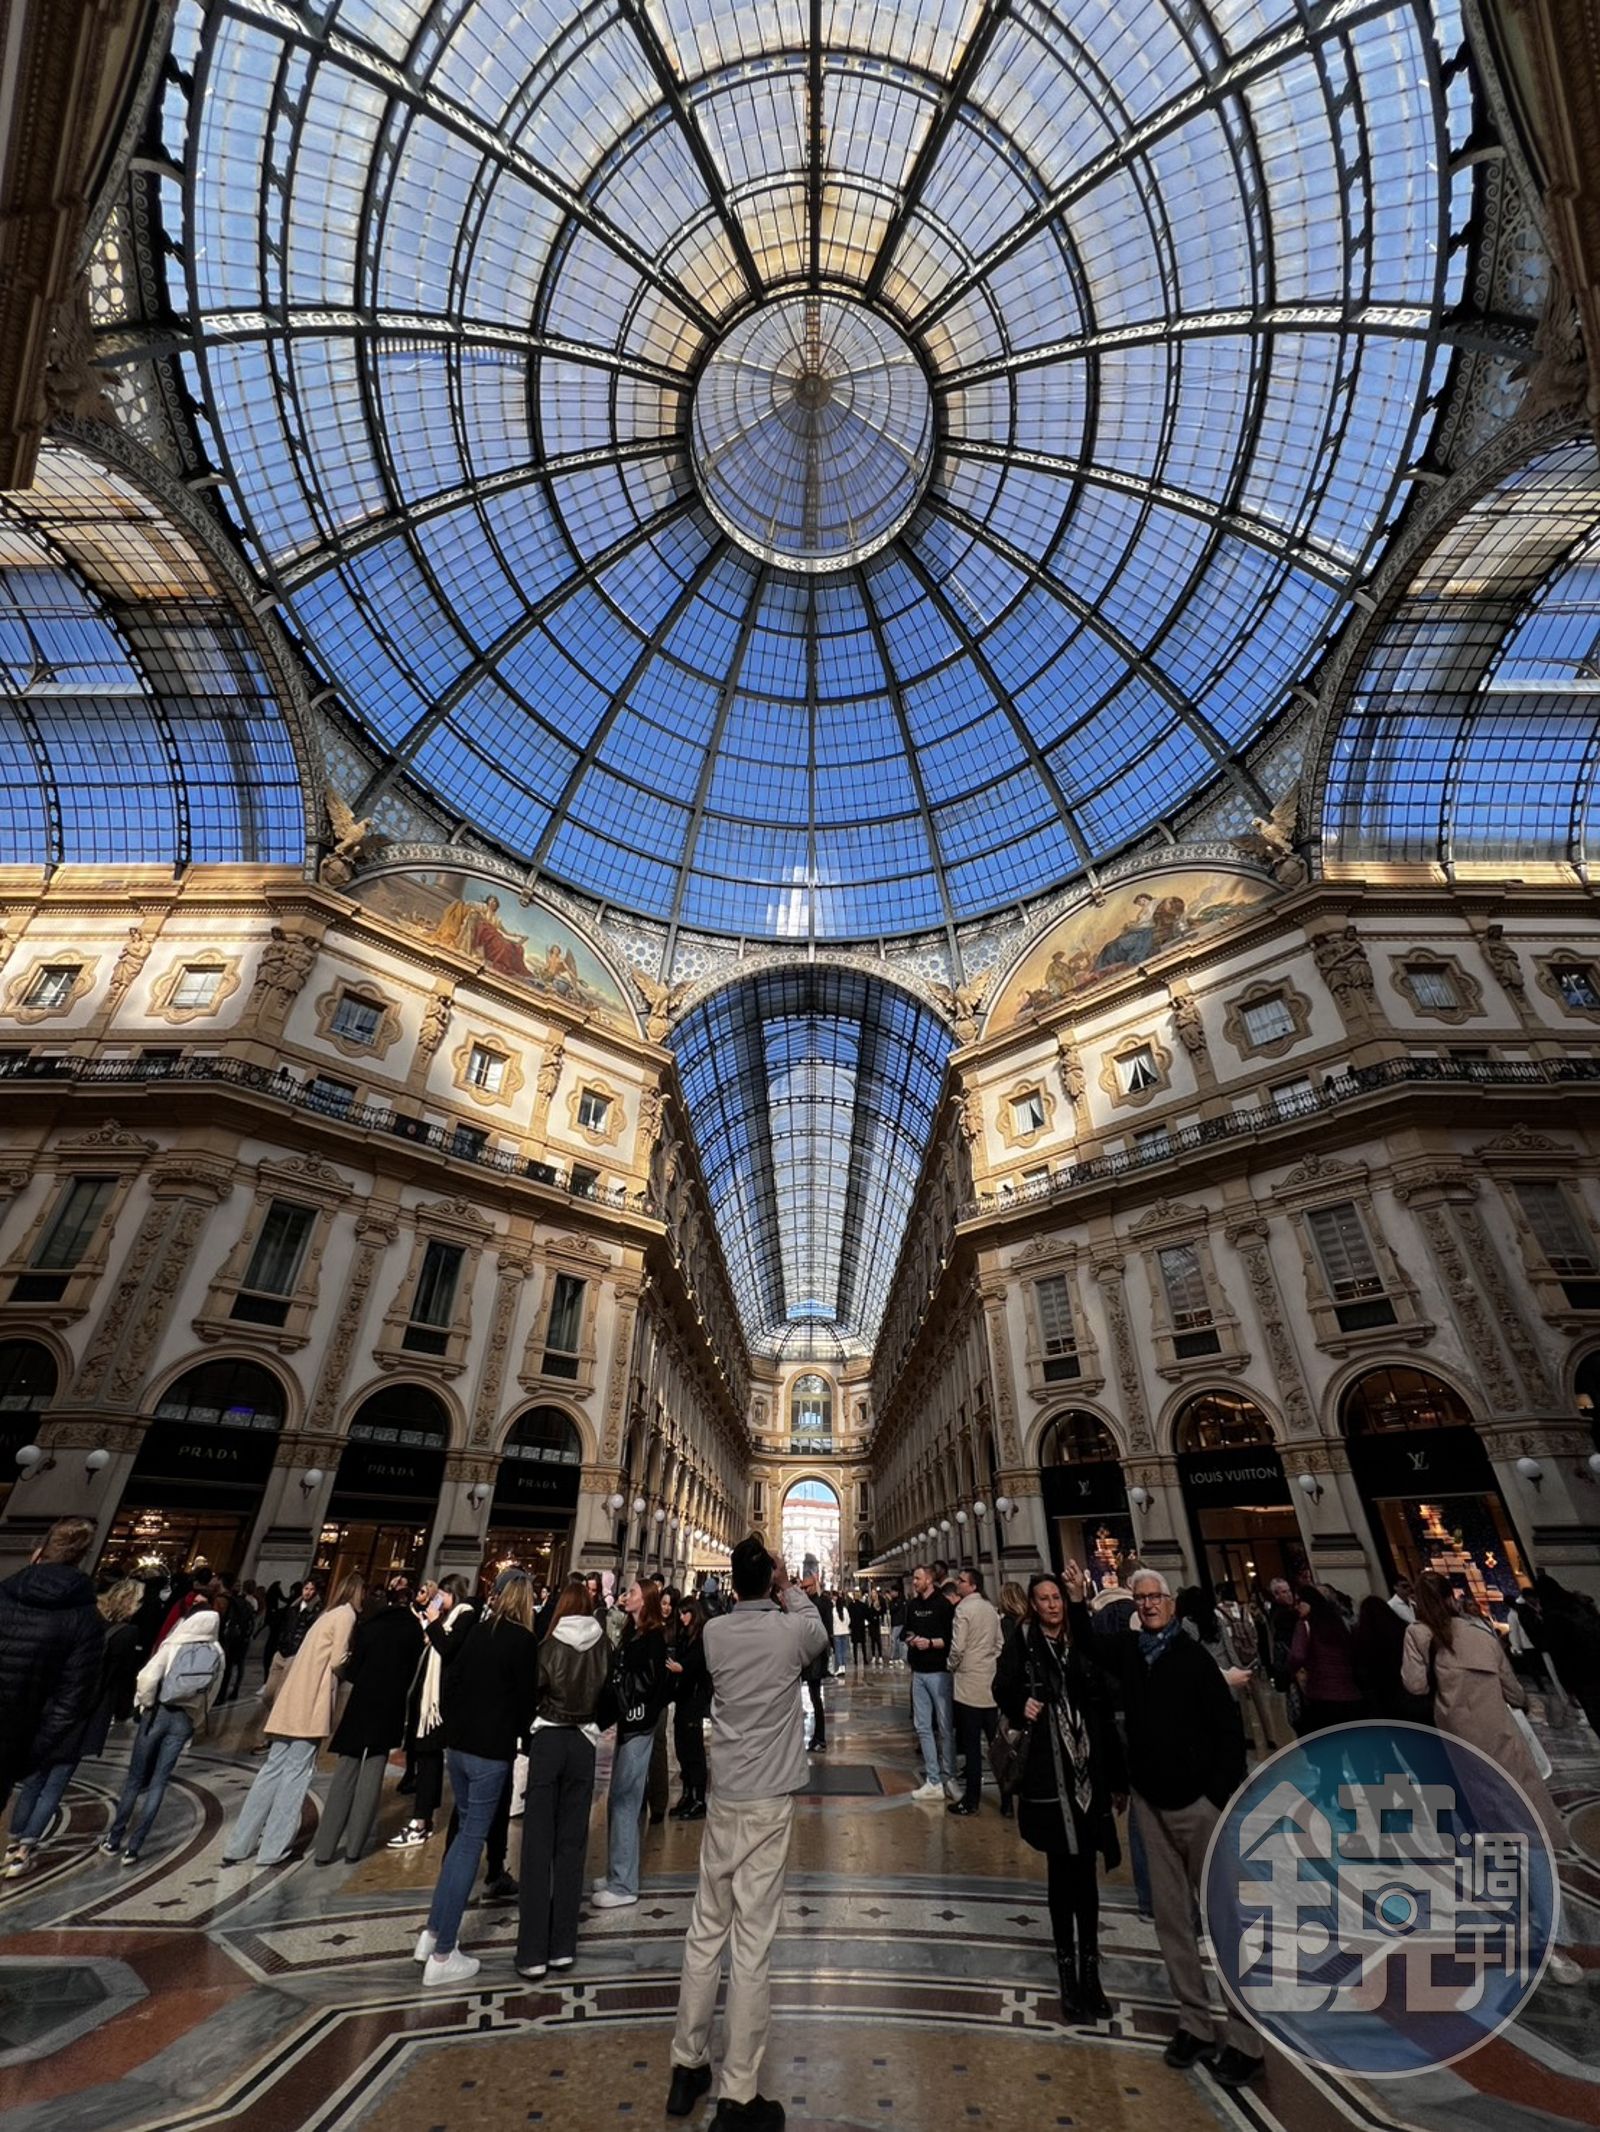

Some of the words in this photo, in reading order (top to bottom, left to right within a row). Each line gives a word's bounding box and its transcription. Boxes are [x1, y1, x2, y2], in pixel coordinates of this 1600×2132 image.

[177, 1445, 239, 1461] PRADA
[367, 1464, 416, 1478] PRADA
[1189, 1471, 1223, 1485] LOUIS
[1224, 1466, 1279, 1482] VUITTON
[517, 1477, 559, 1490] PRADA
